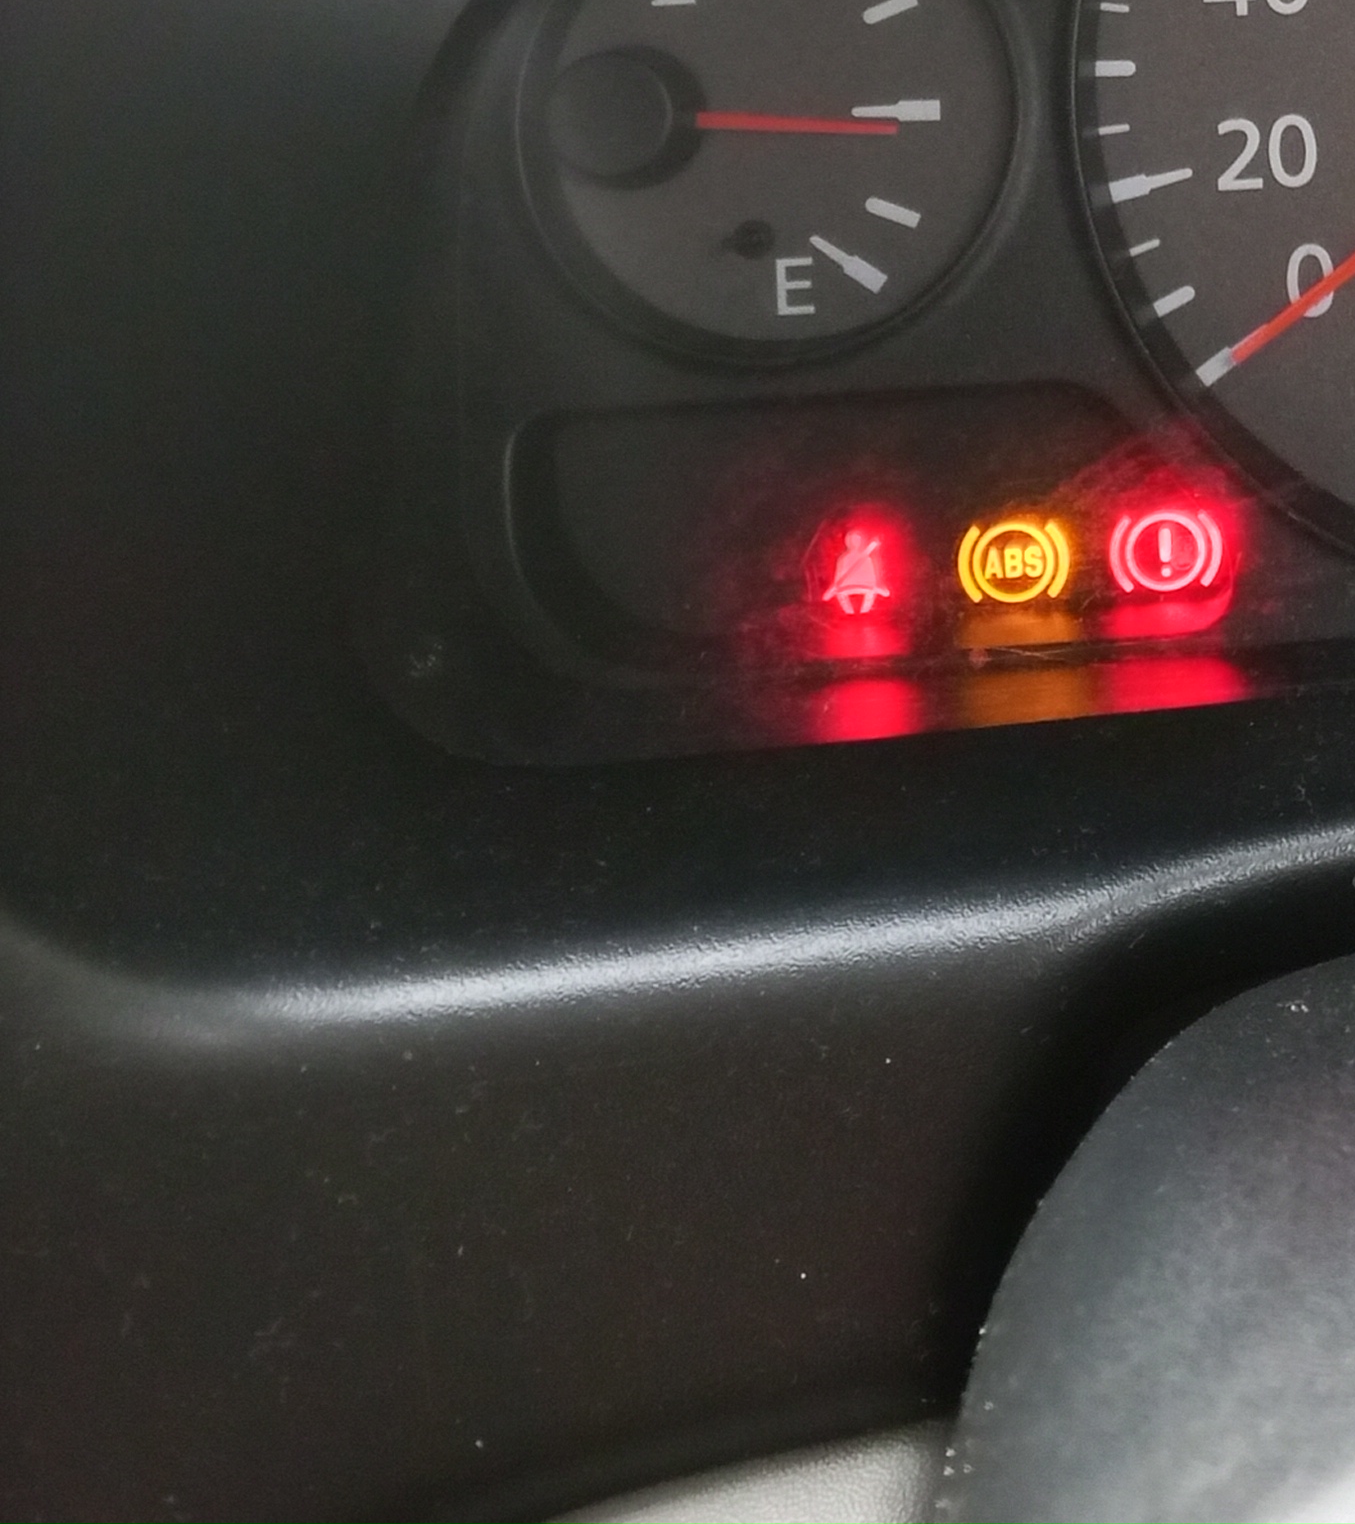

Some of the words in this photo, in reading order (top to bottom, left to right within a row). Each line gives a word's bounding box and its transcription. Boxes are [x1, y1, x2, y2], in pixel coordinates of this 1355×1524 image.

[1216, 113, 1317, 191] 20
[775, 256, 816, 316] E
[1286, 243, 1335, 318] 0
[984, 544, 1044, 580] ABS
